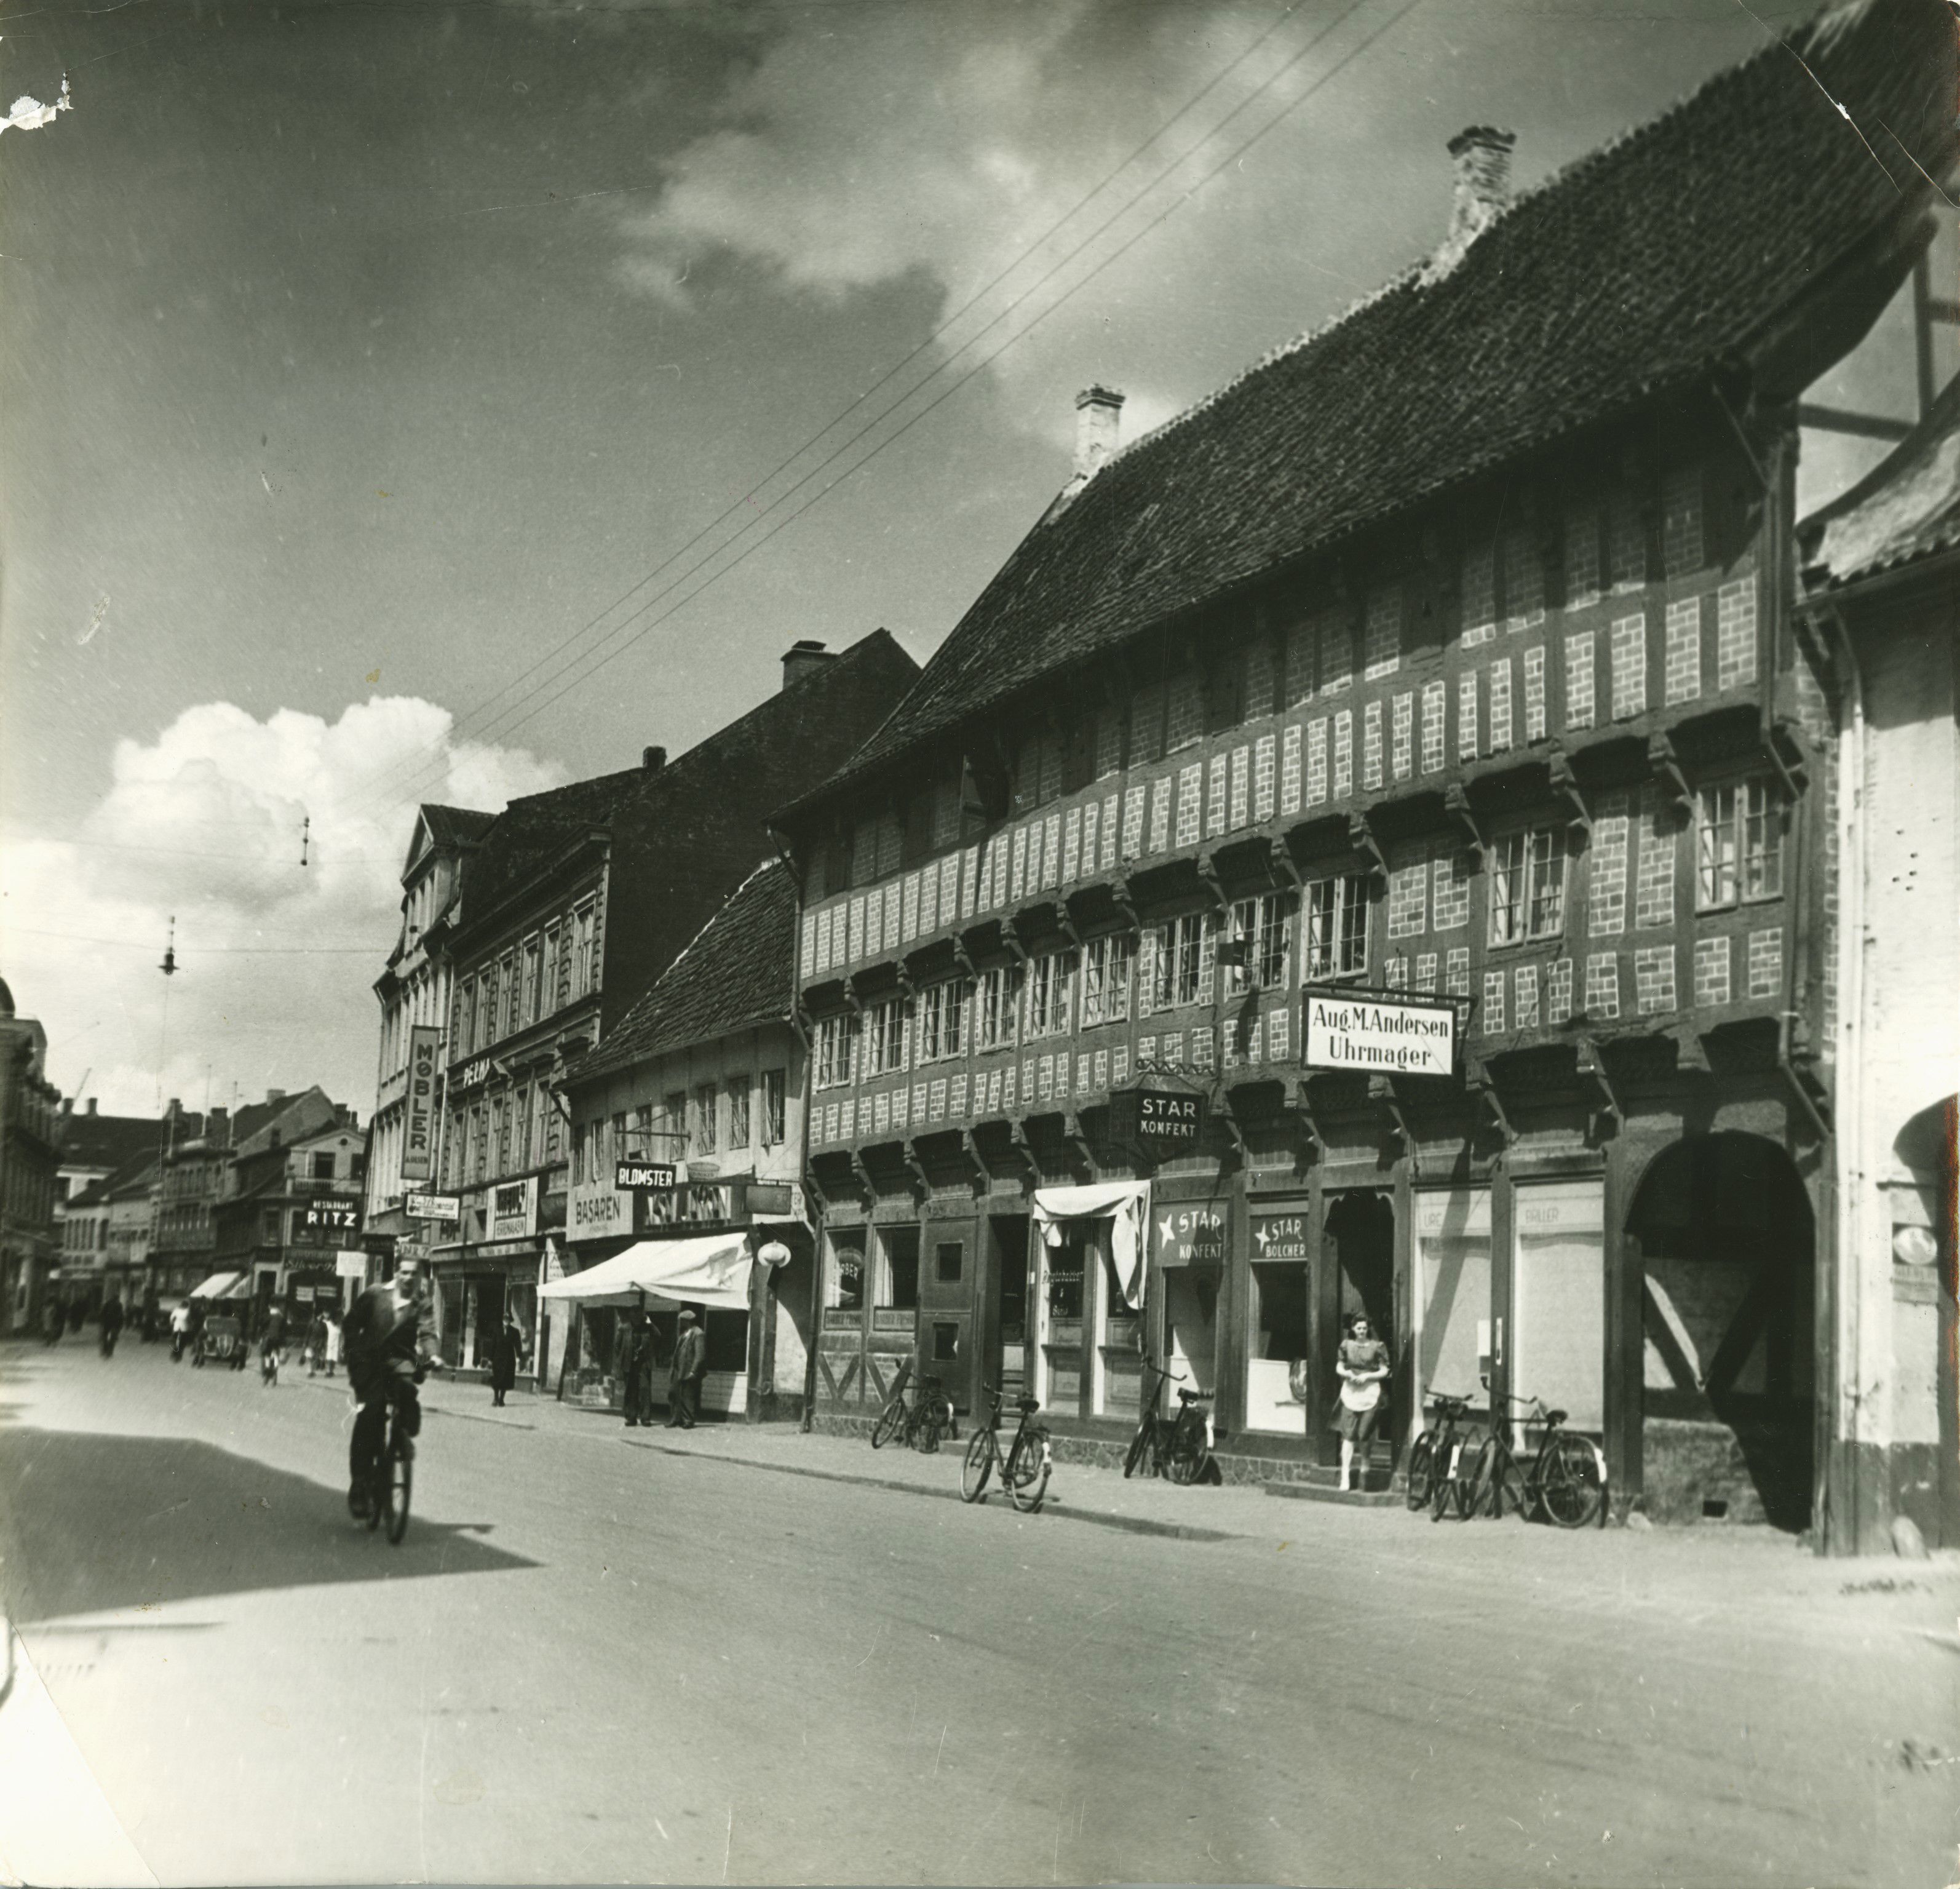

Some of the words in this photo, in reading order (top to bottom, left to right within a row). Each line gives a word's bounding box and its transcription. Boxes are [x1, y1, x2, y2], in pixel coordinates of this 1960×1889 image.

[1330, 1035, 1432, 1071] Uhrmager
[410, 1043, 433, 1150] MØBLER
[1142, 1098, 1196, 1117] STAR
[1140, 1119, 1196, 1137] KONFEKT
[618, 1167, 673, 1187] BLOMSTER
[307, 1211, 357, 1227] RITZ
[576, 1196, 621, 1225] BASAREN
[1179, 1211, 1221, 1240] STAR
[1272, 1219, 1303, 1241] STAR
[1180, 1244, 1223, 1260] KONFEKT
[1266, 1244, 1306, 1258] BOLCHER
